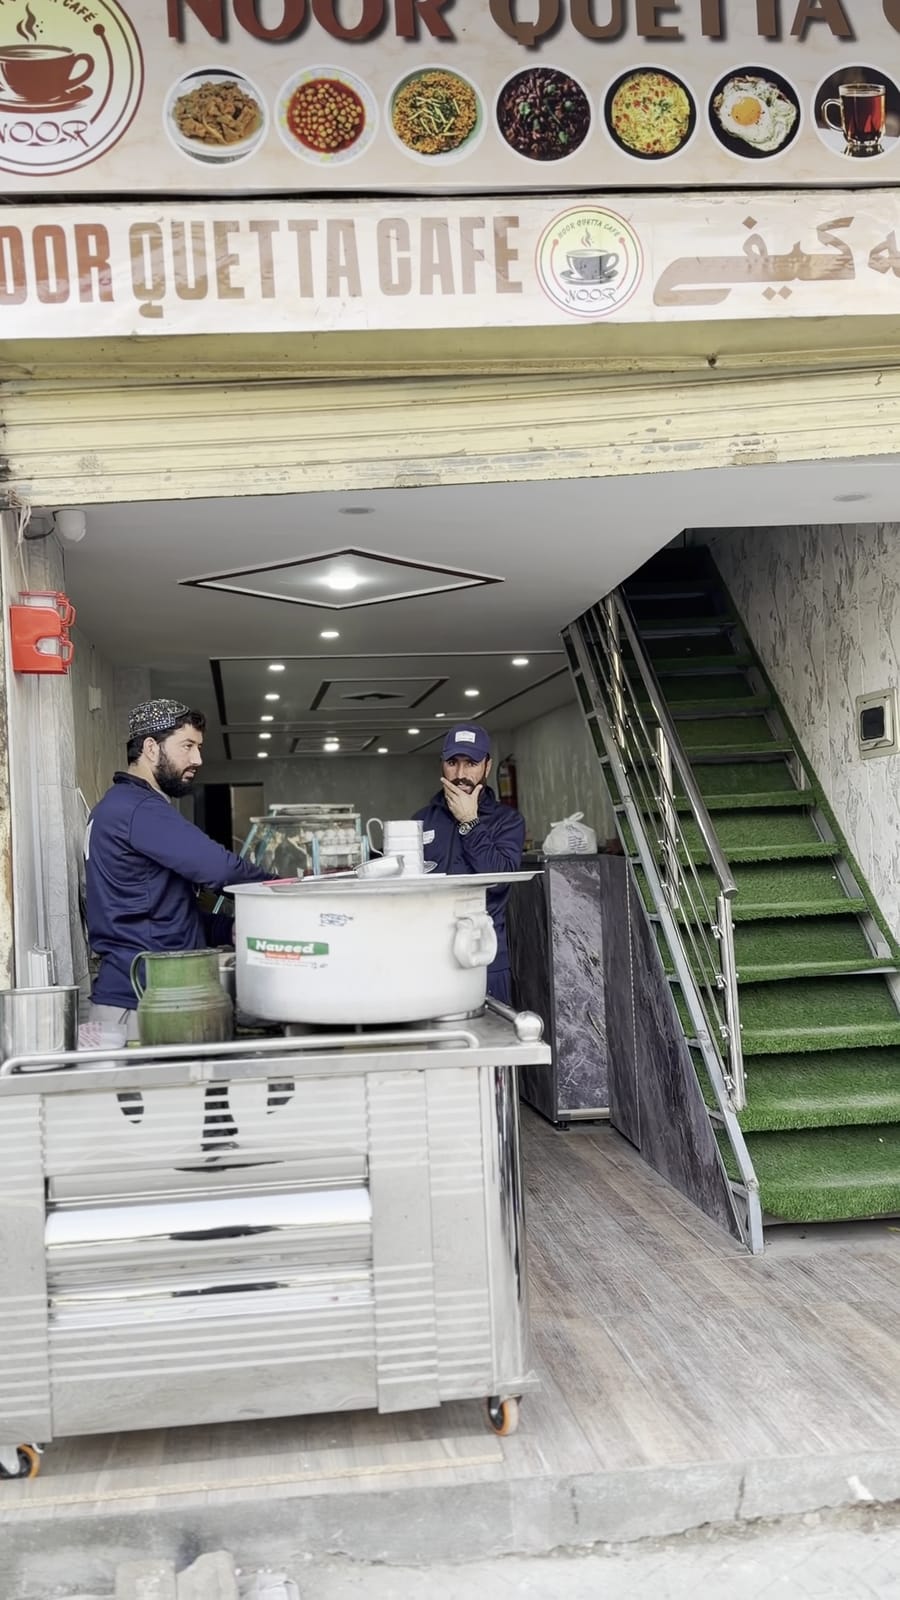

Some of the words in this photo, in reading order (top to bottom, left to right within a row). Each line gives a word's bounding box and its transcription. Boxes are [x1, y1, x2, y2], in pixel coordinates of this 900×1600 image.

[128, 219, 363, 318] QUETTA
[376, 216, 523, 296] CAFE
[565, 287, 617, 304] NOOR
[255, 939, 314, 954] Naveed
